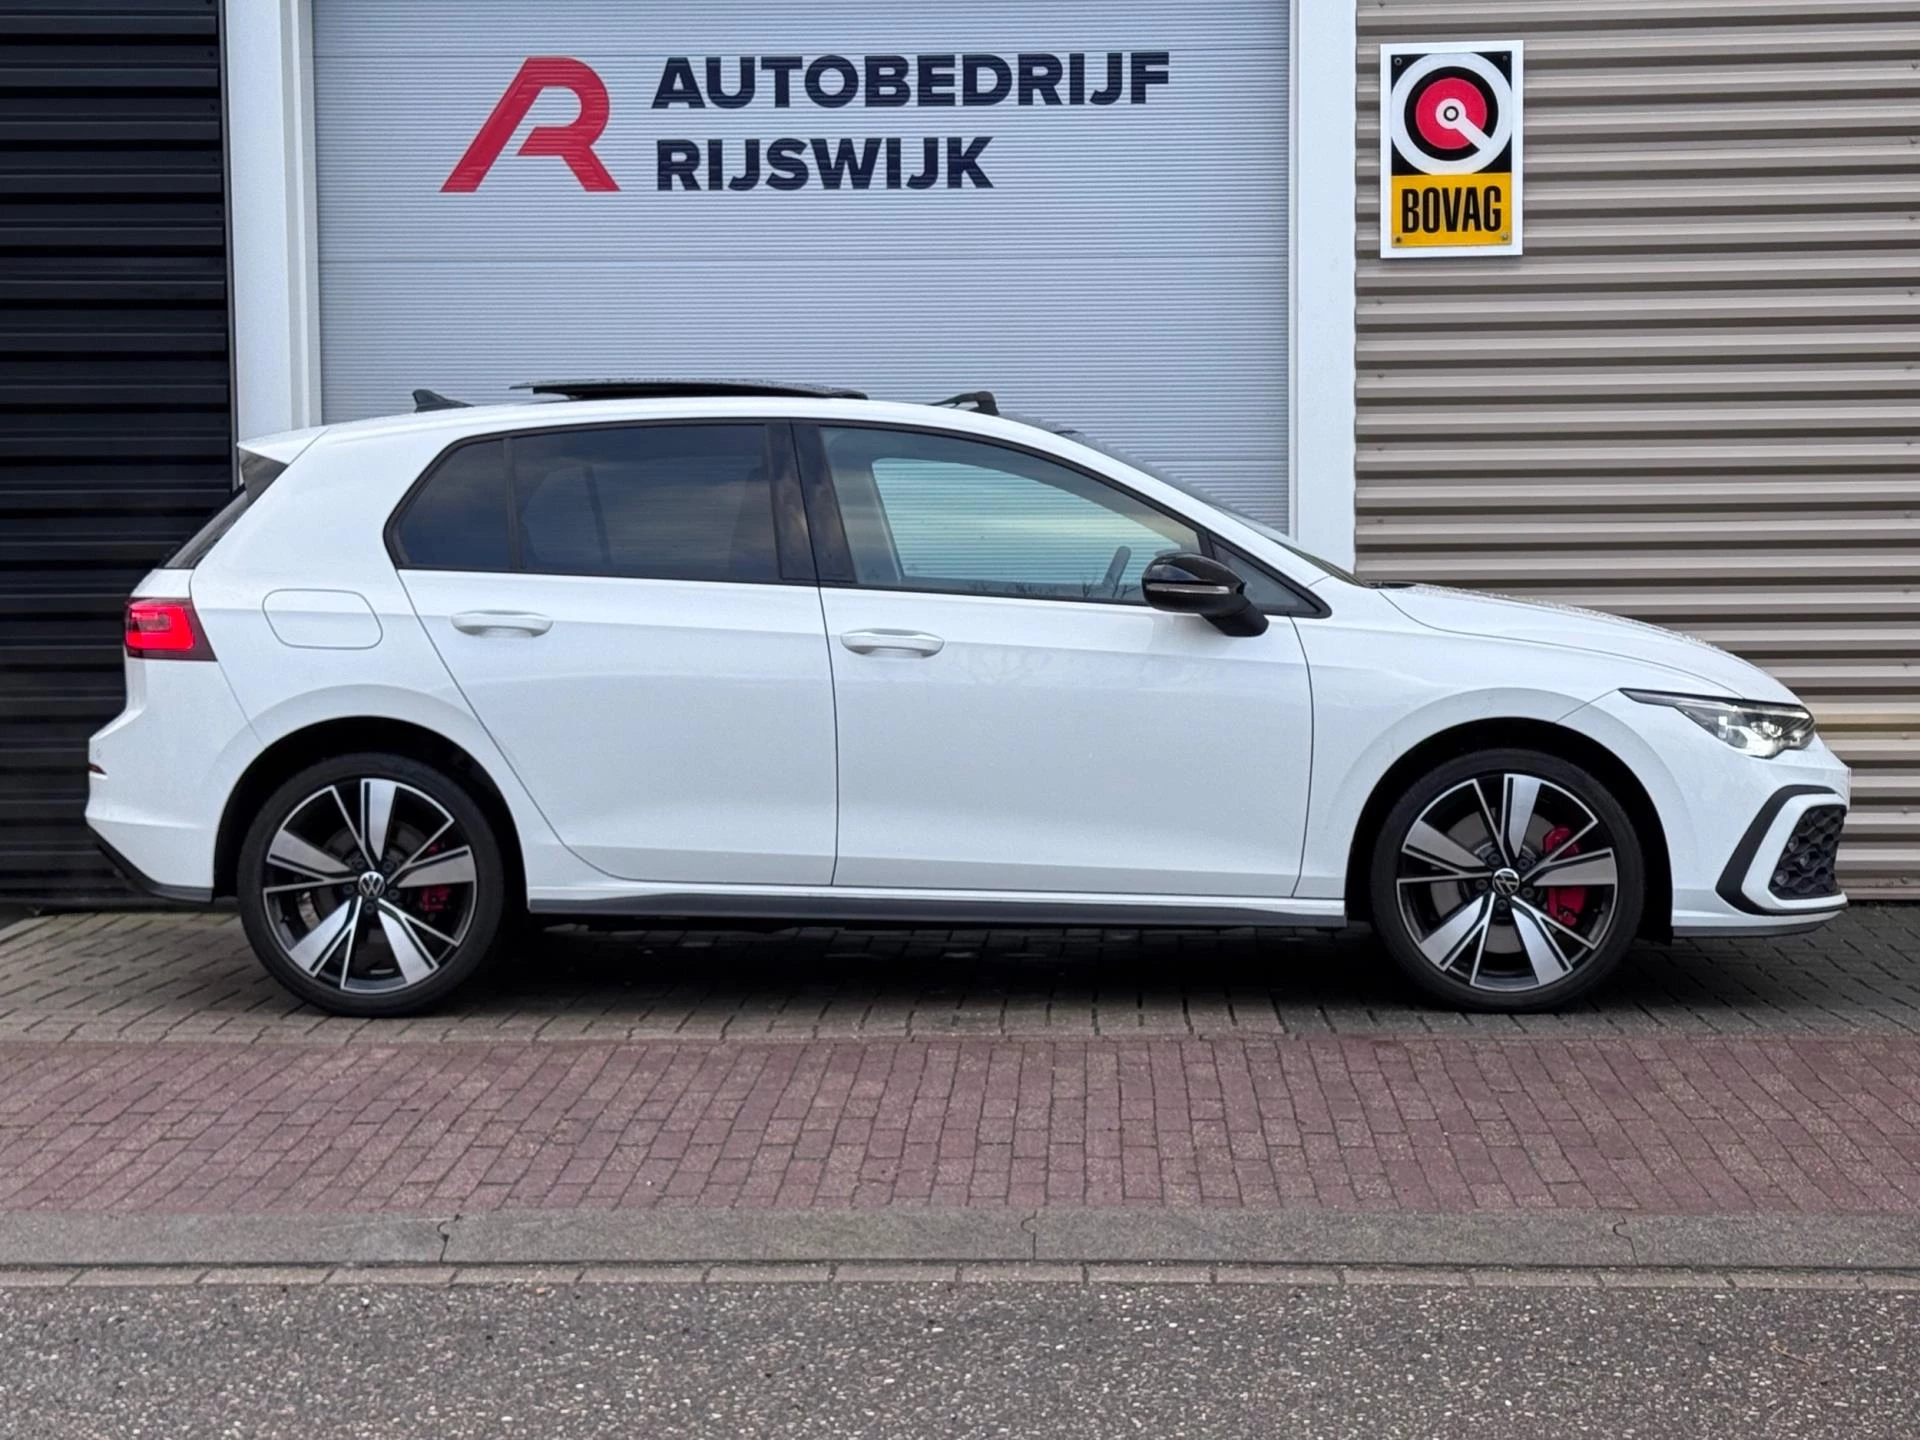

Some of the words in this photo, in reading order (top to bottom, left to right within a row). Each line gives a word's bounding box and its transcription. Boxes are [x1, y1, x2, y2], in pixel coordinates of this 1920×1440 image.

[652, 52, 1170, 109] AUTOBEDRIJF
[656, 136, 994, 191] RIJSWIJK
[1402, 186, 1501, 233] BOVAG
